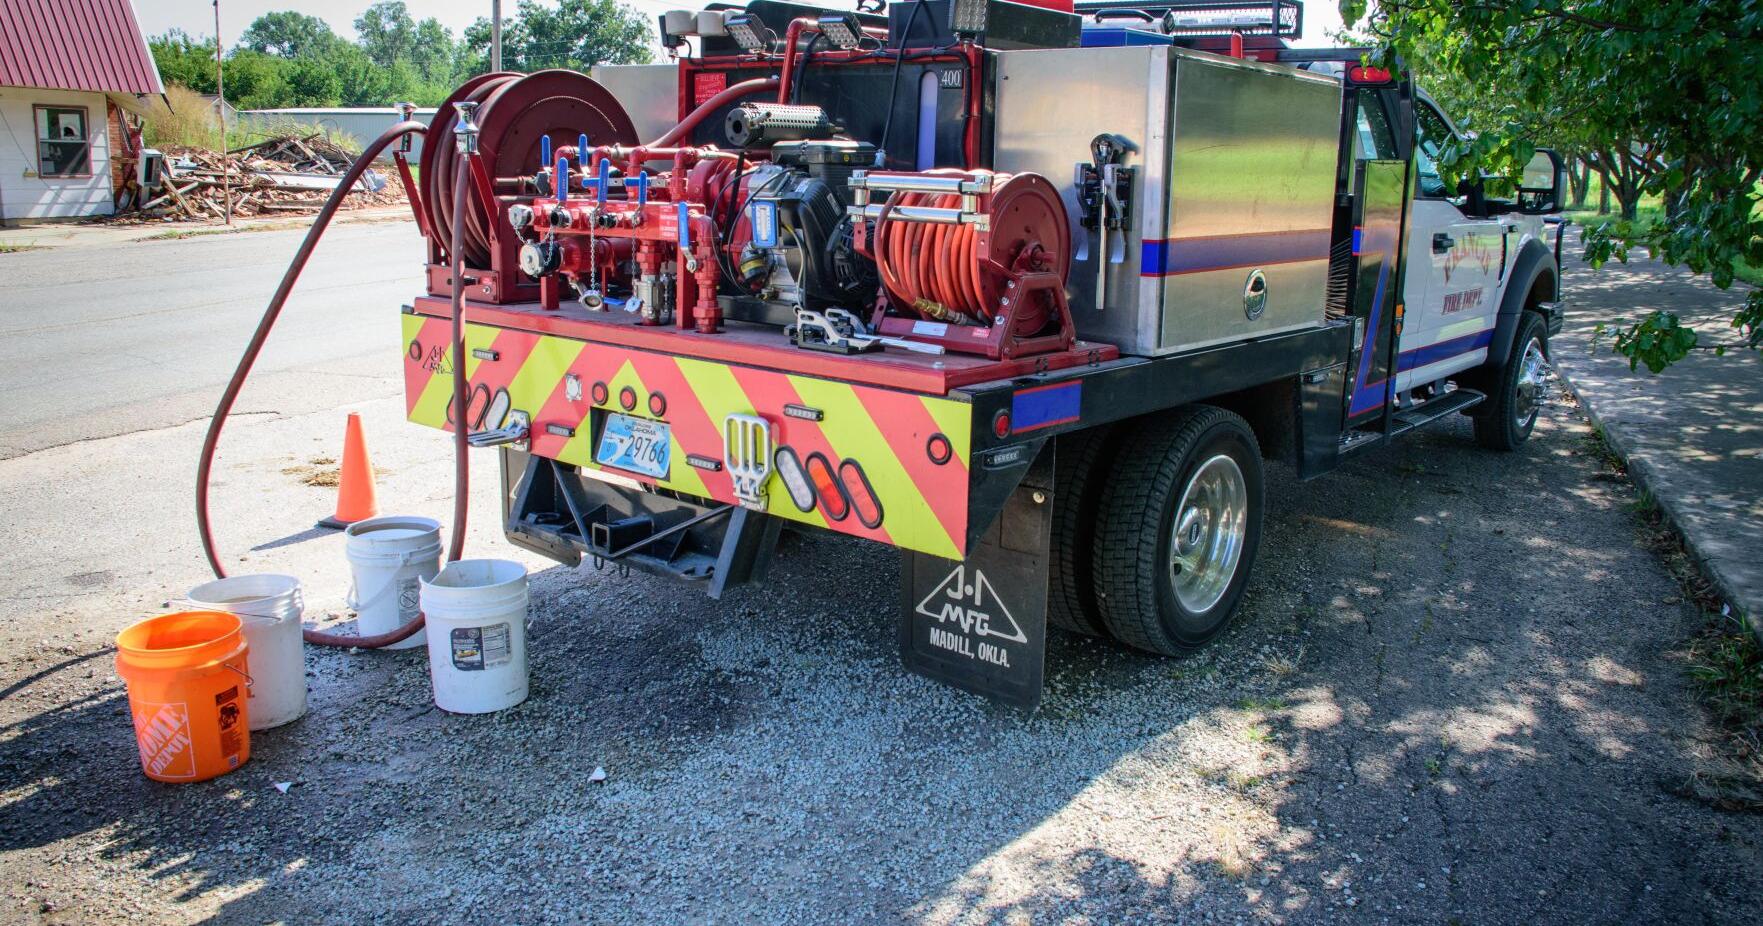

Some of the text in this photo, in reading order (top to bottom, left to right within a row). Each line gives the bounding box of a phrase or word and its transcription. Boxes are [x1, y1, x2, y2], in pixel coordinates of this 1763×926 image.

[941, 70, 960, 86] 400
[1442, 291, 1463, 315] FIRE
[624, 424, 657, 436] OKLAHOMA
[624, 434, 667, 465] 29766
[939, 603, 990, 637] MFG
[929, 627, 1010, 668] MADILL, OKLA.
[150, 731, 191, 775] DEPOT
